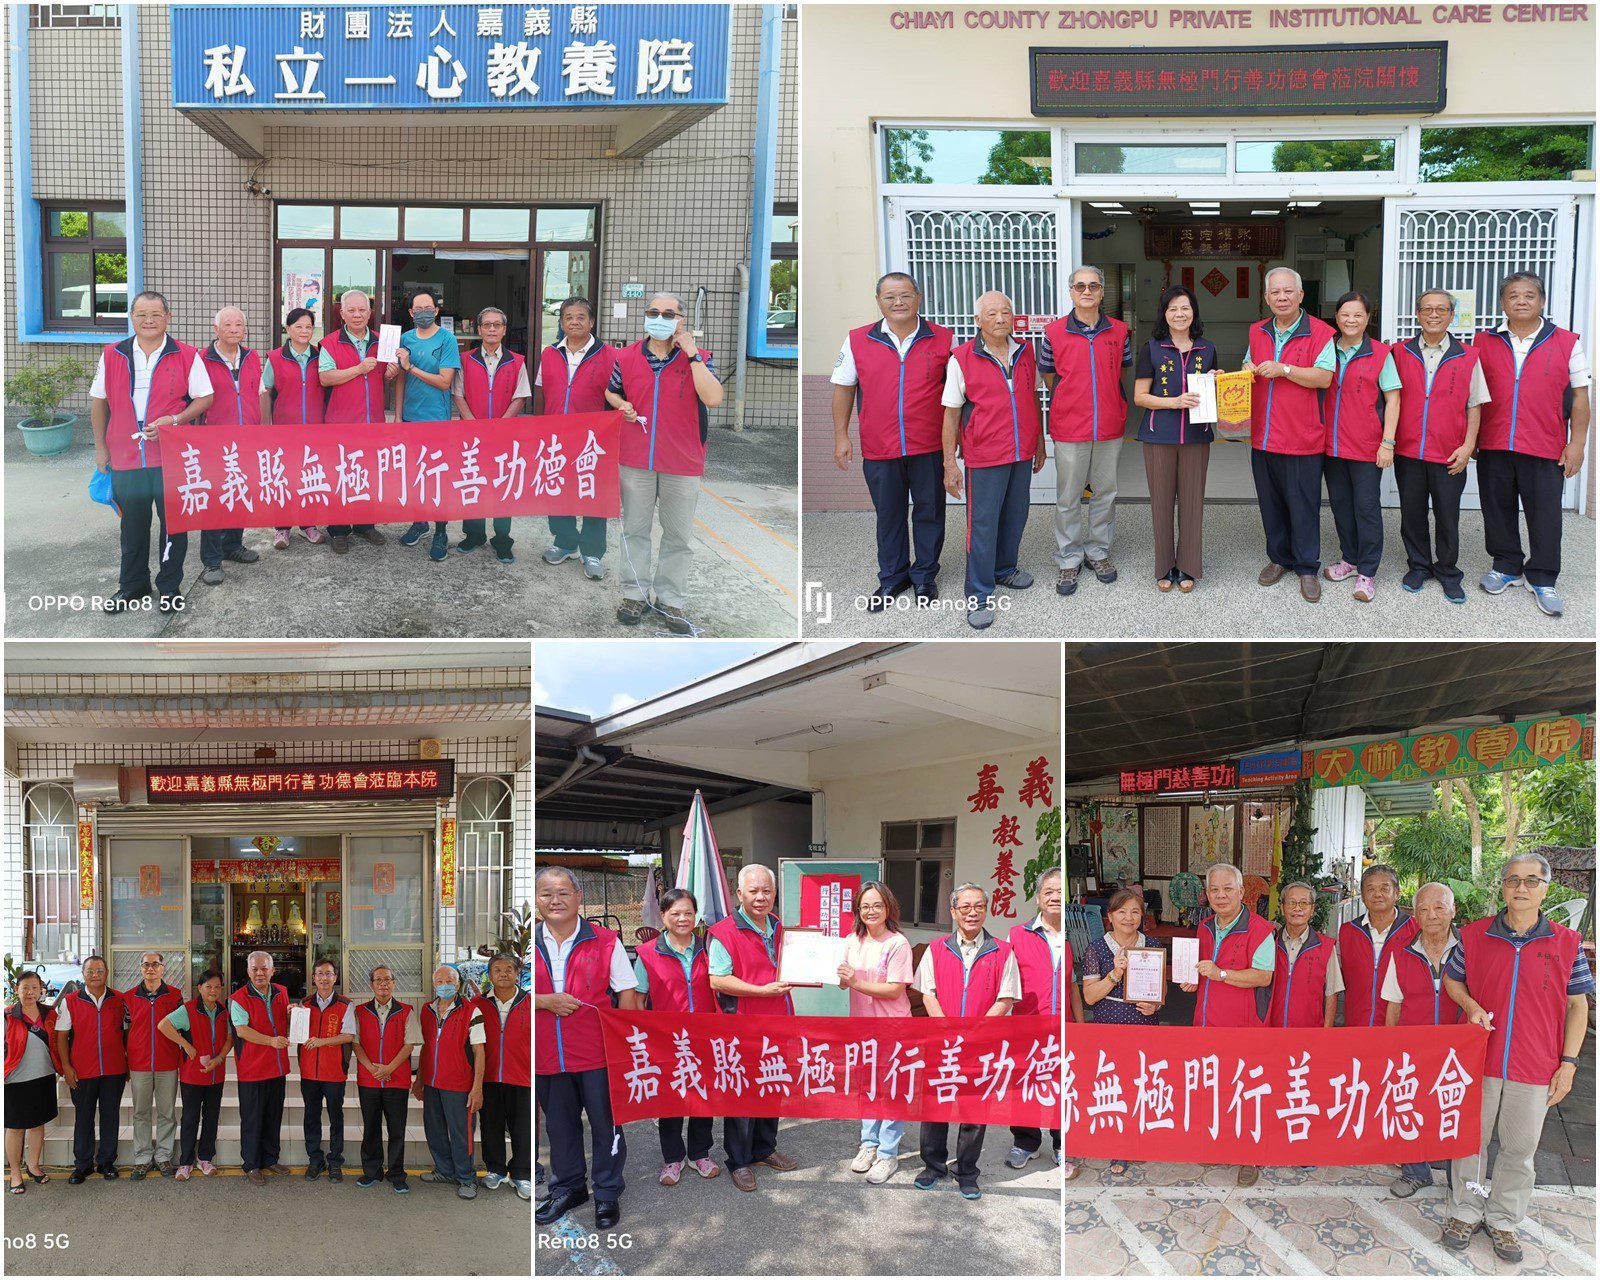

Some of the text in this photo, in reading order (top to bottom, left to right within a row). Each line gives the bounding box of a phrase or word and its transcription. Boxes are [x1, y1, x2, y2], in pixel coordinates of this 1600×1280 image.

[299, 5, 599, 39] 財團法人嘉義縣
[890, 4, 1588, 30] CHIAYI COUNTY ZHONGPU PRIVATE INSTITUTIONAL CARE CENTER
[203, 38, 696, 100] 私立一心教養院
[177, 430, 608, 517] 嘉義縣無極門行善功德會
[1242, 776, 1264, 784] Teaching
[1264, 774, 1285, 782] Activity
[1316, 719, 1577, 780] 大林教養院
[990, 815, 1024, 919] 教養院
[624, 1026, 1061, 1107] 嘉義縣無極門行善功德
